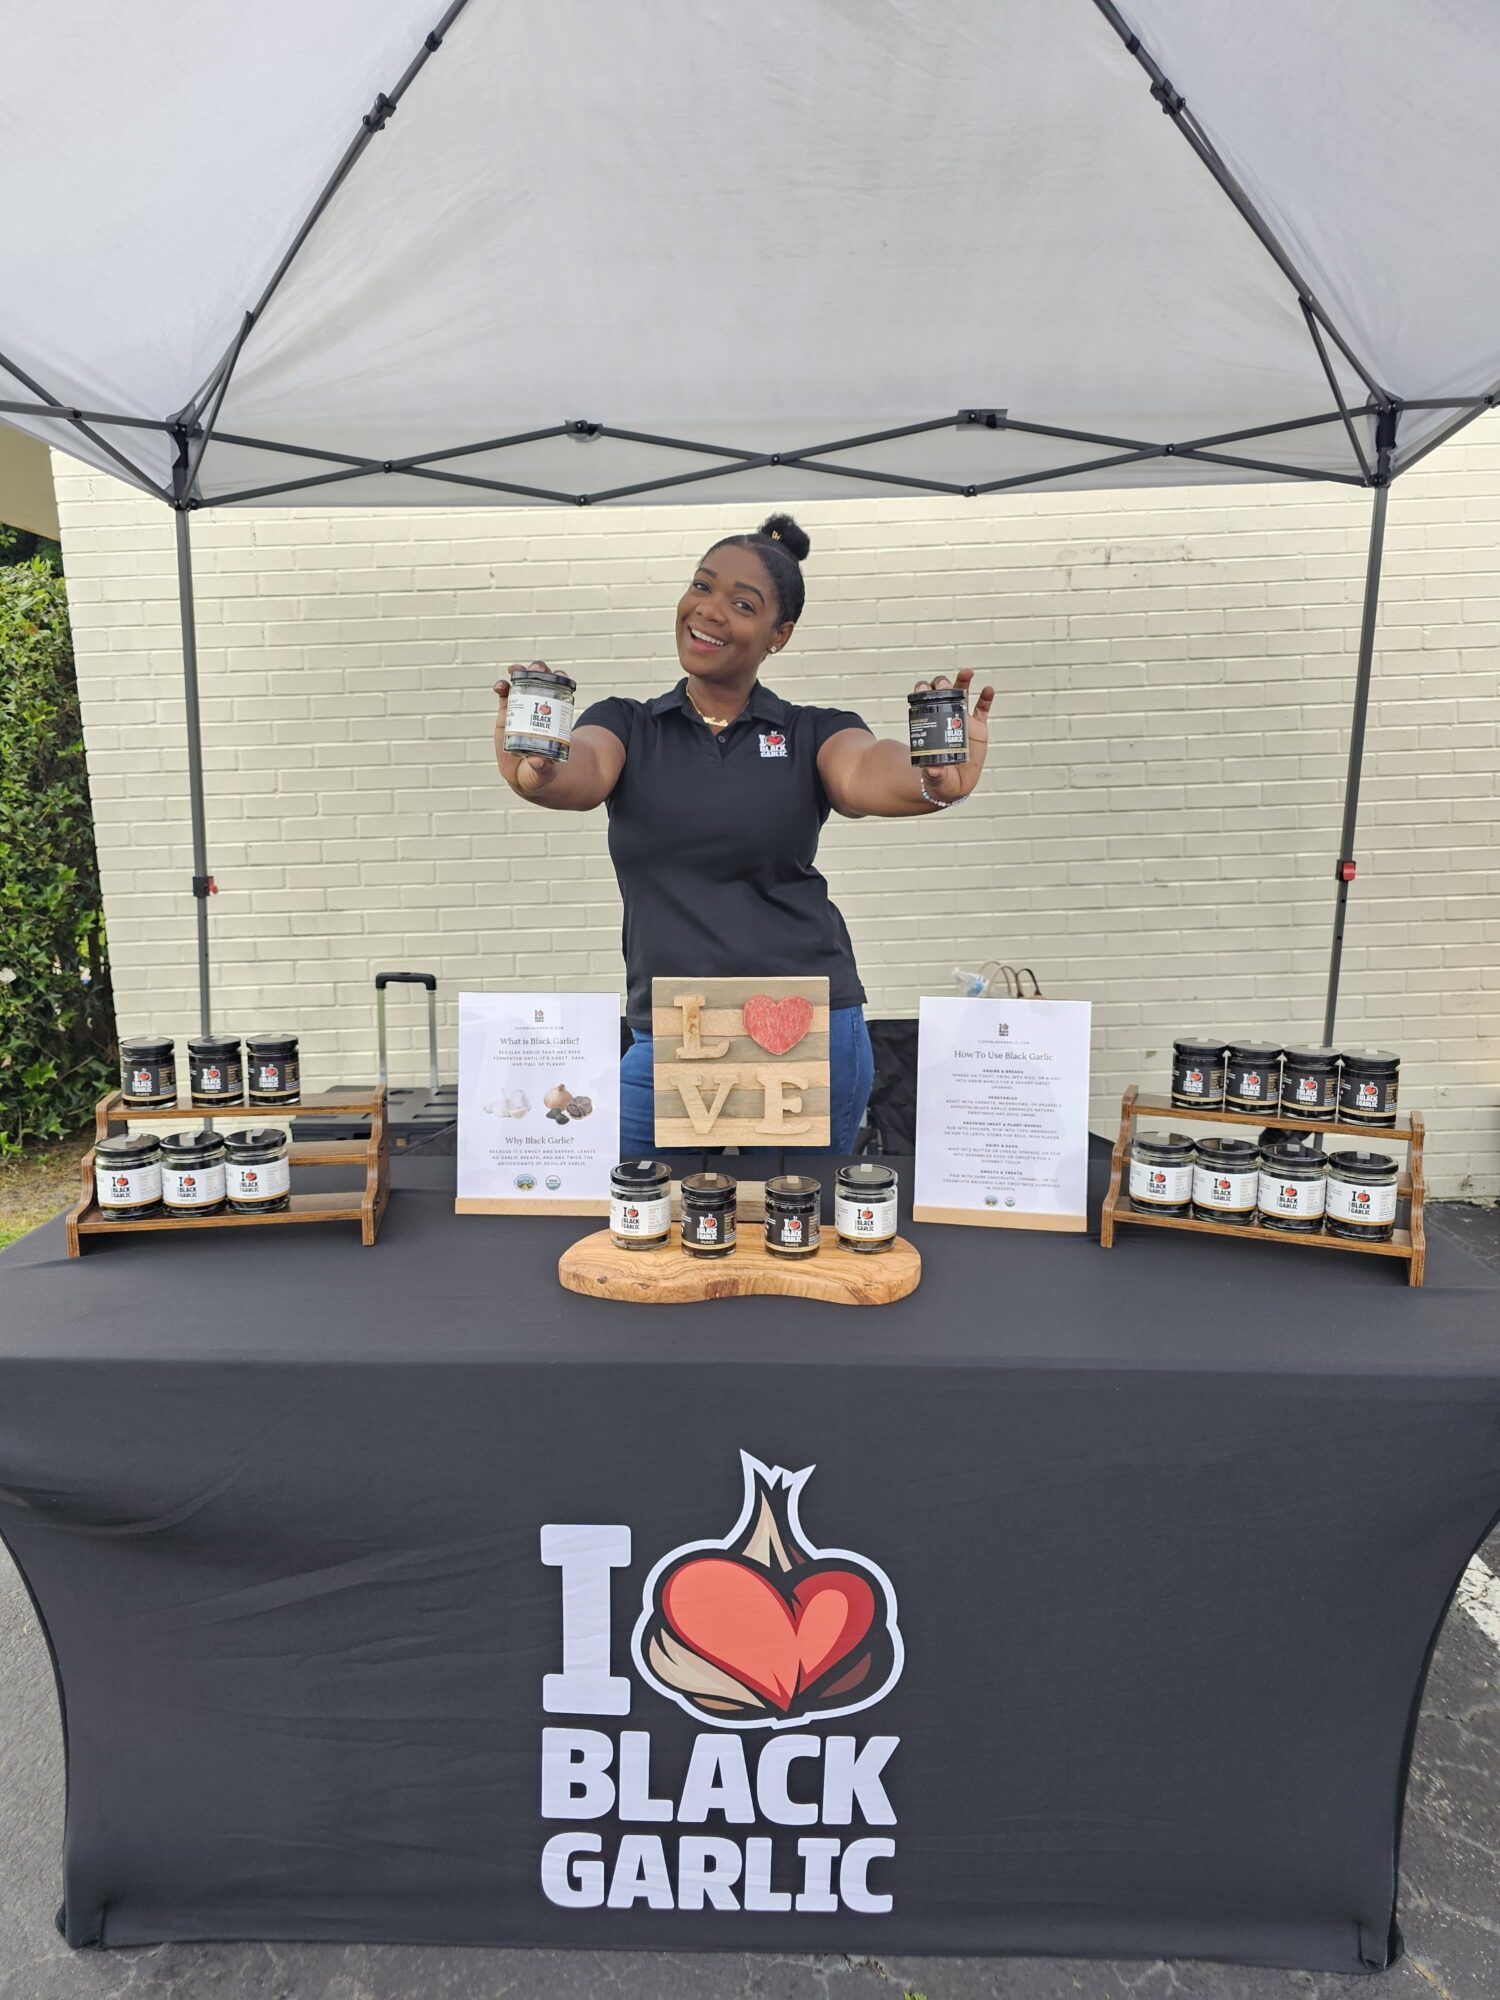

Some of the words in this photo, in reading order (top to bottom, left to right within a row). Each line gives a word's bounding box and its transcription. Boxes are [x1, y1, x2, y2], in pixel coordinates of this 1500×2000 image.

[534, 702, 539, 714] I
[532, 715, 552, 723] BLACK
[946, 718, 952, 730] I
[532, 721, 551, 730] GARLIC
[759, 734, 766, 746] I
[760, 744, 786, 752] BLACK
[500, 1037, 521, 1045] What
[523, 1037, 529, 1045] is
[530, 1037, 551, 1045] Black
[553, 1037, 580, 1045] Garlic?
[954, 1050, 973, 1058] How
[975, 1051, 986, 1059] To
[988, 1051, 1003, 1059] Use
[1005, 1052, 1027, 1060] Black
[1029, 1052, 1054, 1061] Garlic
[133, 1071, 139, 1082] I
[202, 1068, 208, 1078] I
[260, 1067, 266, 1077] I
[1186, 1070, 1191, 1081] I
[1185, 1080, 1203, 1088] BLACK
[1243, 1074, 1249, 1084] I
[1299, 1079, 1305, 1089] I
[1299, 1089, 1317, 1097] BLACK
[1359, 1084, 1365, 1095] I
[1359, 1094, 1378, 1102] BLACK
[505, 1137, 524, 1146] Why
[179, 1177, 183, 1186] I
[241, 1172, 245, 1181] I
[1150, 1172, 1154, 1182] I
[112, 1177, 116, 1187] I
[1214, 1178, 1218, 1188] I
[1280, 1186, 1284, 1196] I
[1352, 1191, 1357, 1202] I
[623, 1207, 627, 1217] I
[858, 1209, 861, 1219] I
[699, 1216, 704, 1227] I
[784, 1219, 789, 1230] I
[540, 1523, 632, 1716] I
[541, 1727, 901, 1826] BLACK
[540, 1832, 896, 1913] GARLIC
